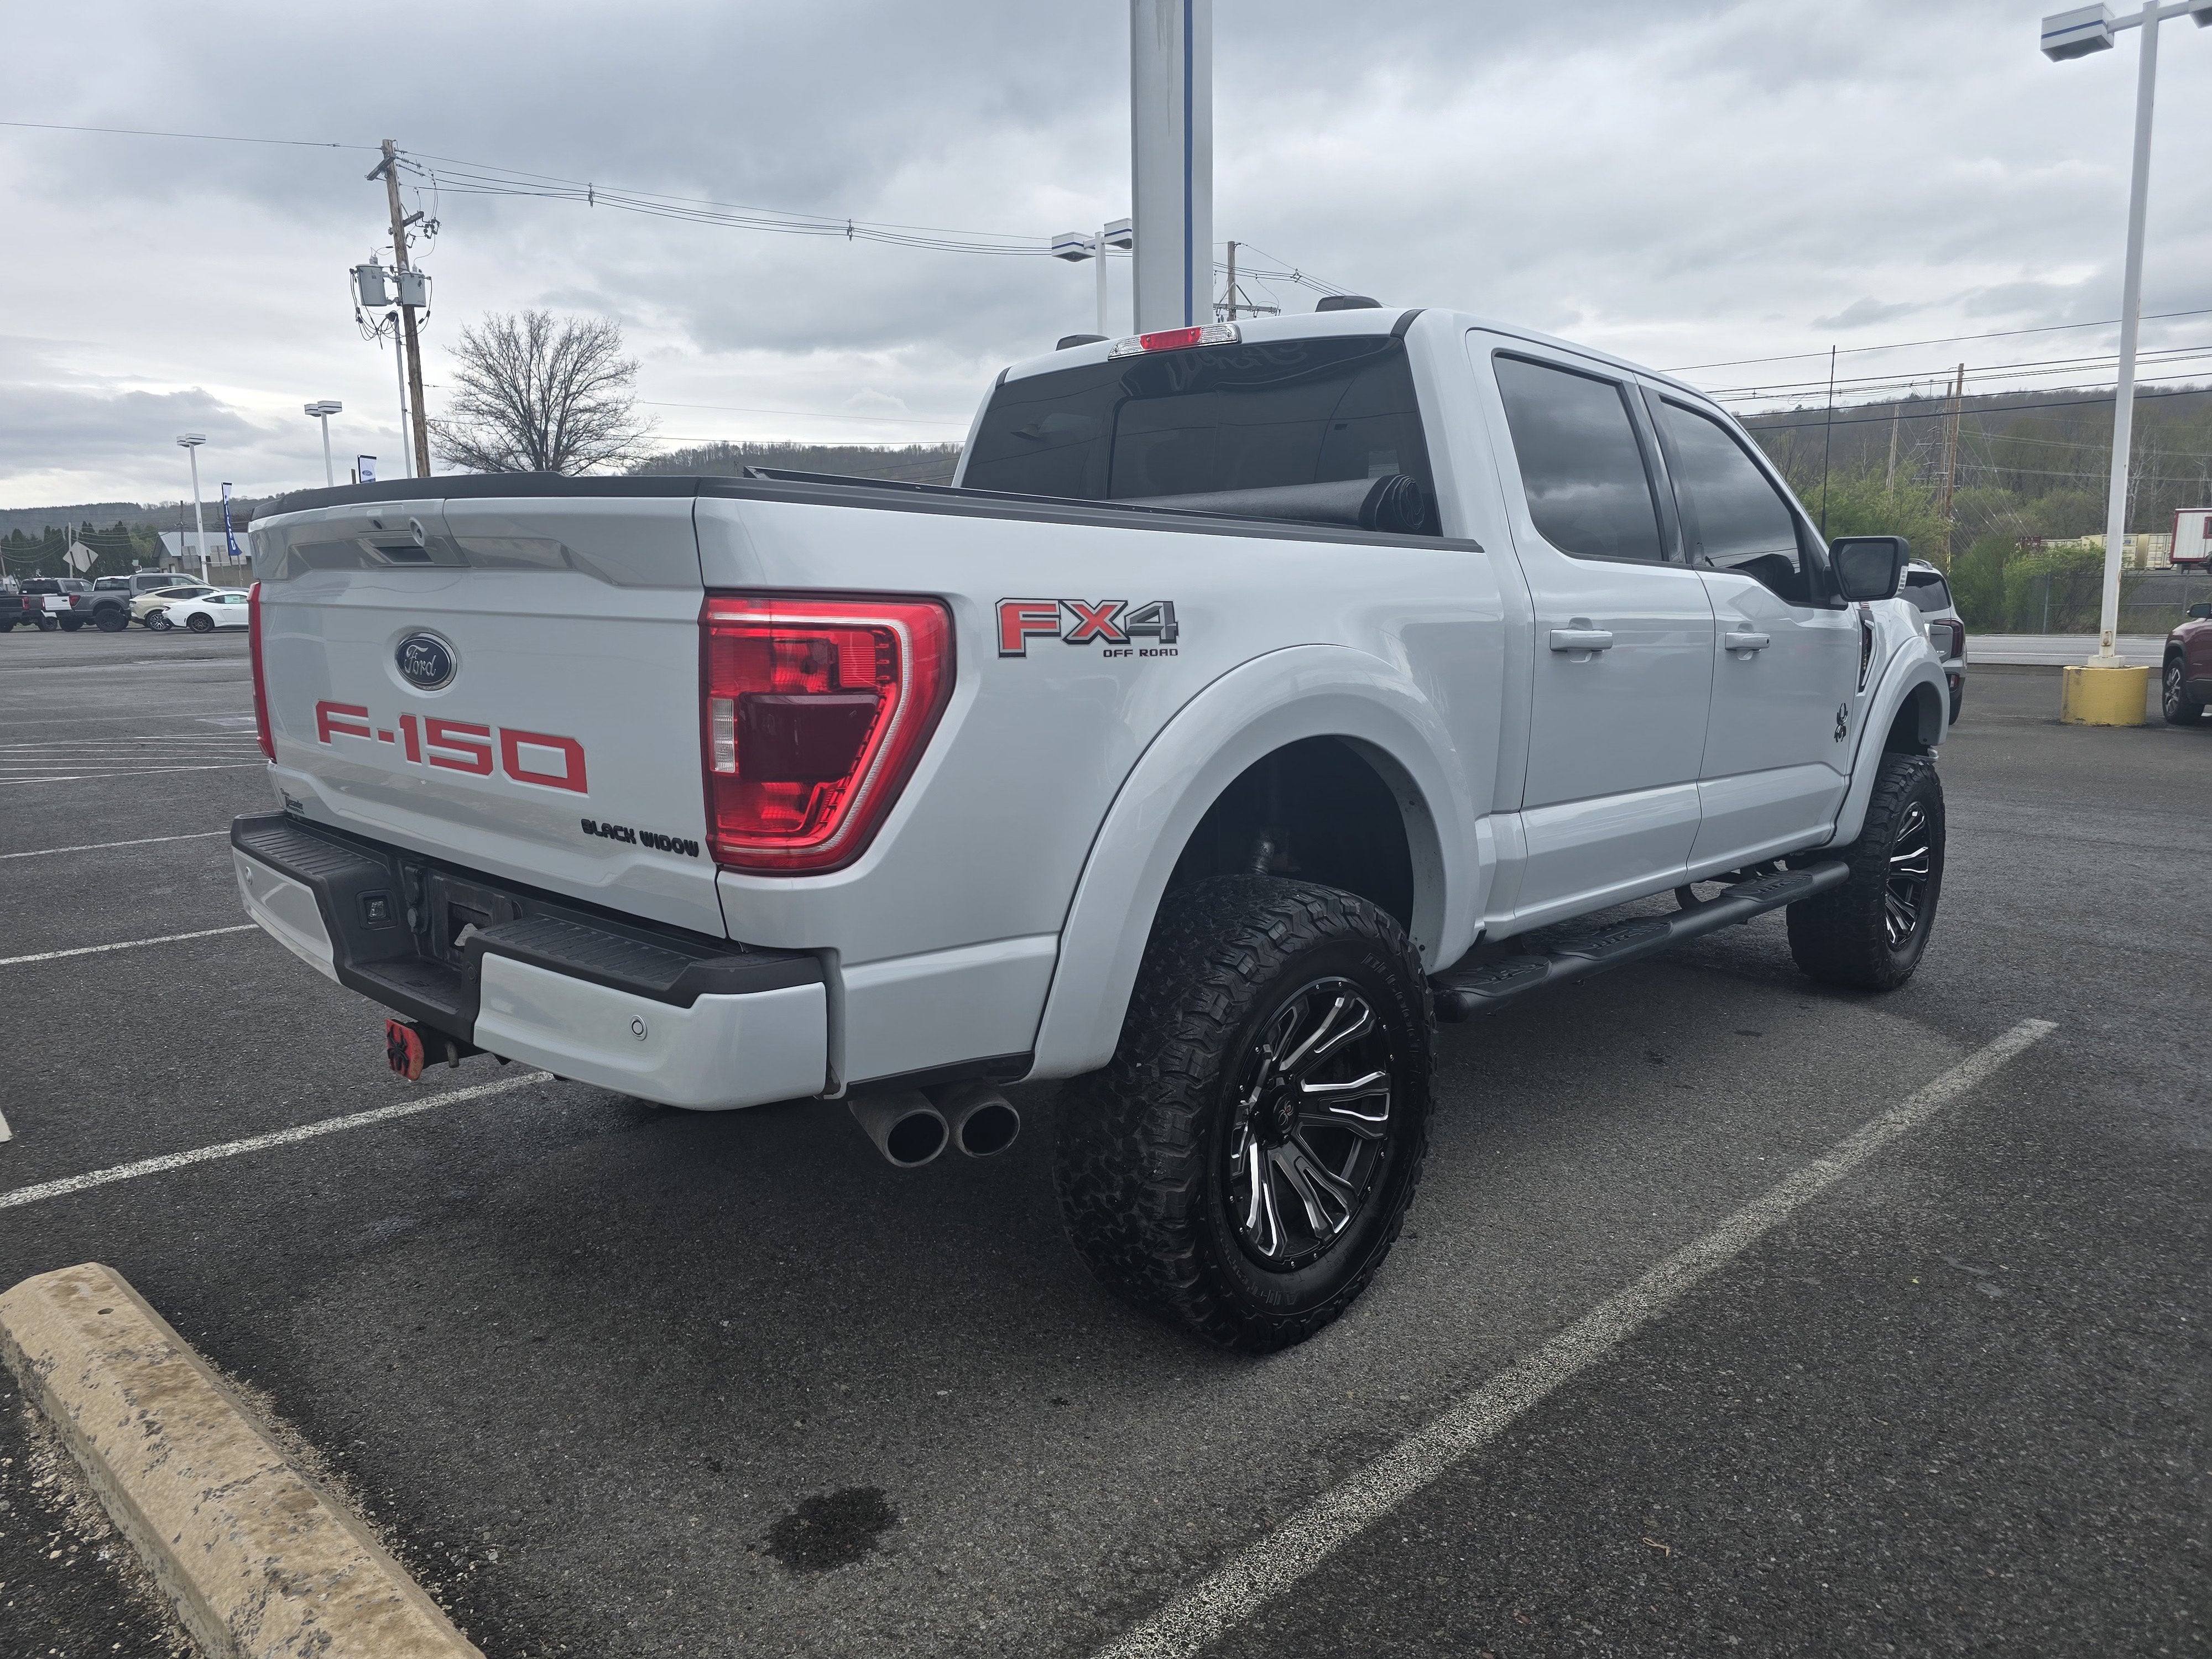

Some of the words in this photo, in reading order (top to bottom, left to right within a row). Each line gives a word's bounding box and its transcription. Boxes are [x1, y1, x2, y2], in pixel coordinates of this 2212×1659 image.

[995, 597, 1179, 659] FX4
[404, 644, 437, 676] Ford
[1103, 649, 1134, 658] OFF
[1139, 648, 1178, 657] ROAD
[315, 700, 588, 794] F-150
[581, 818, 637, 844] BLACK
[639, 830, 699, 858] WIDOW
